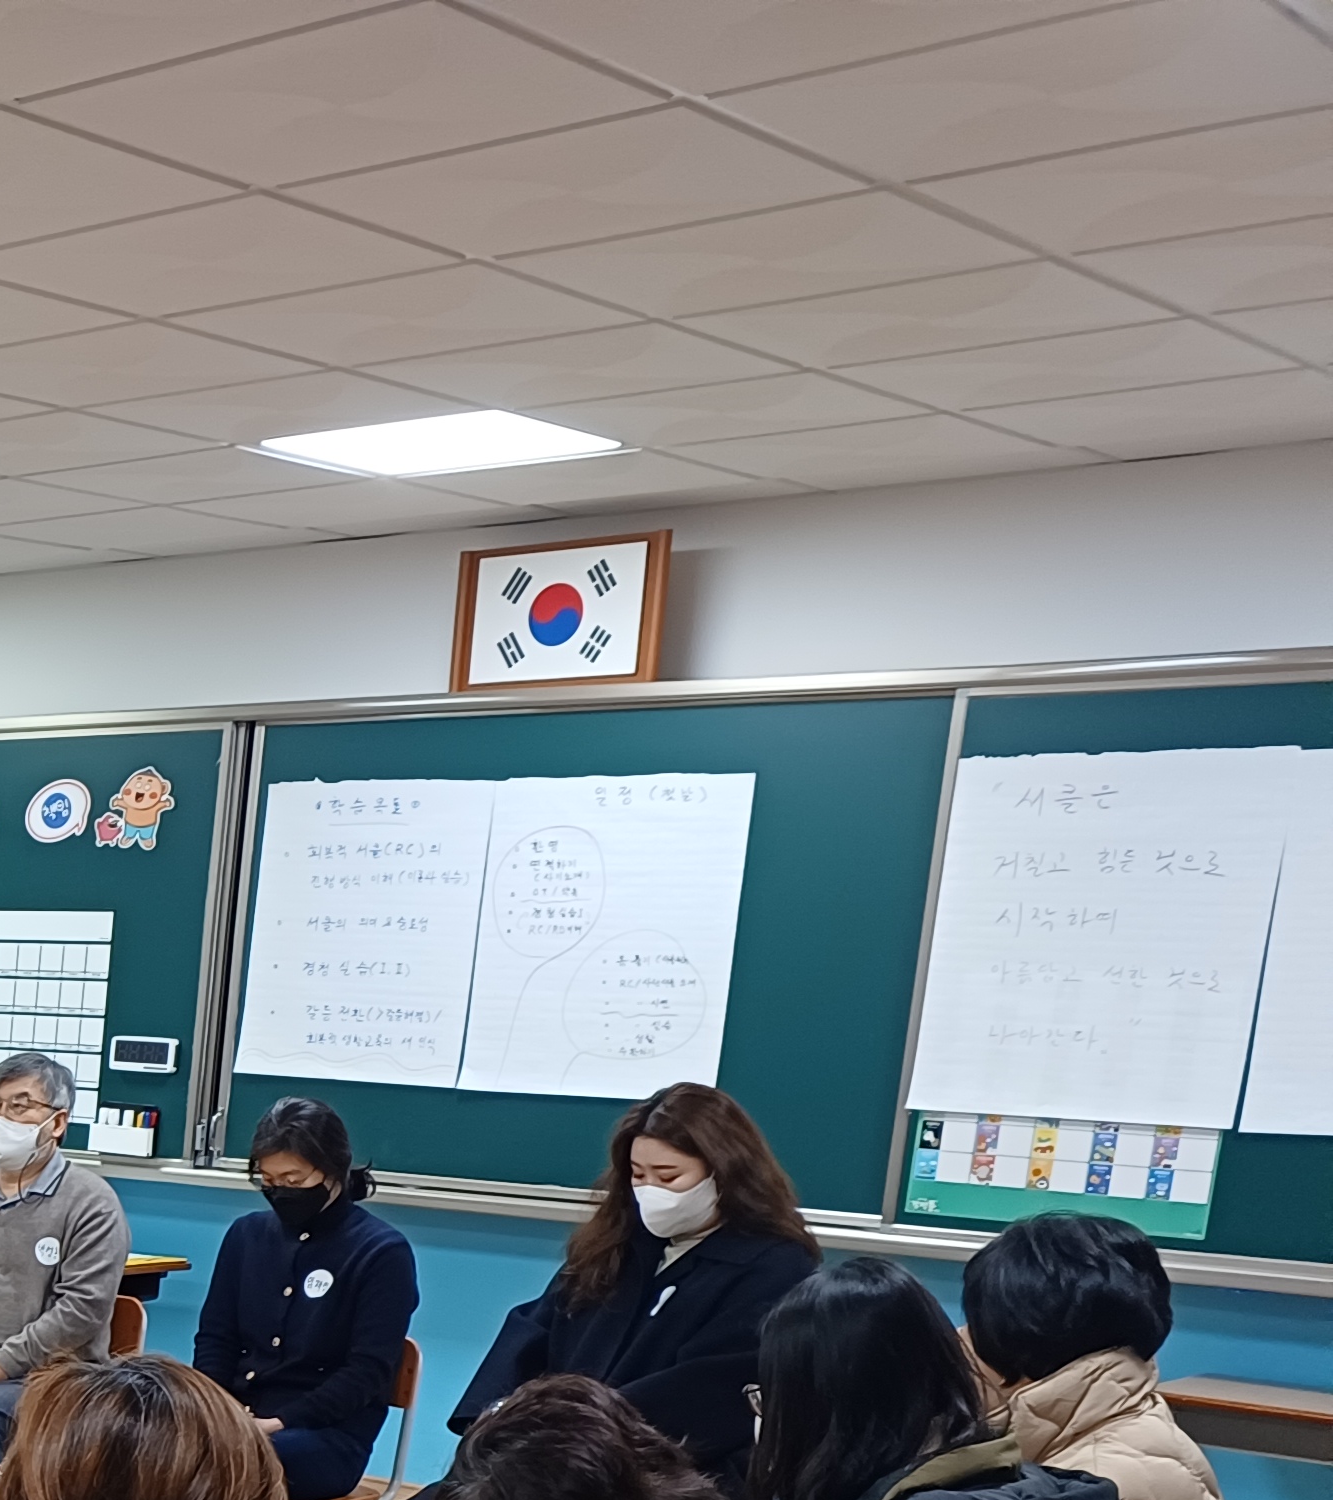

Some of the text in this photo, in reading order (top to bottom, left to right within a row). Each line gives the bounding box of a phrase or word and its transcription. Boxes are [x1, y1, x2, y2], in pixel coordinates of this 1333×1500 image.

[993, 846, 1227, 880] 거칠고 힘든 것으로
[989, 959, 1223, 994] 아름답고 선한 것으로
